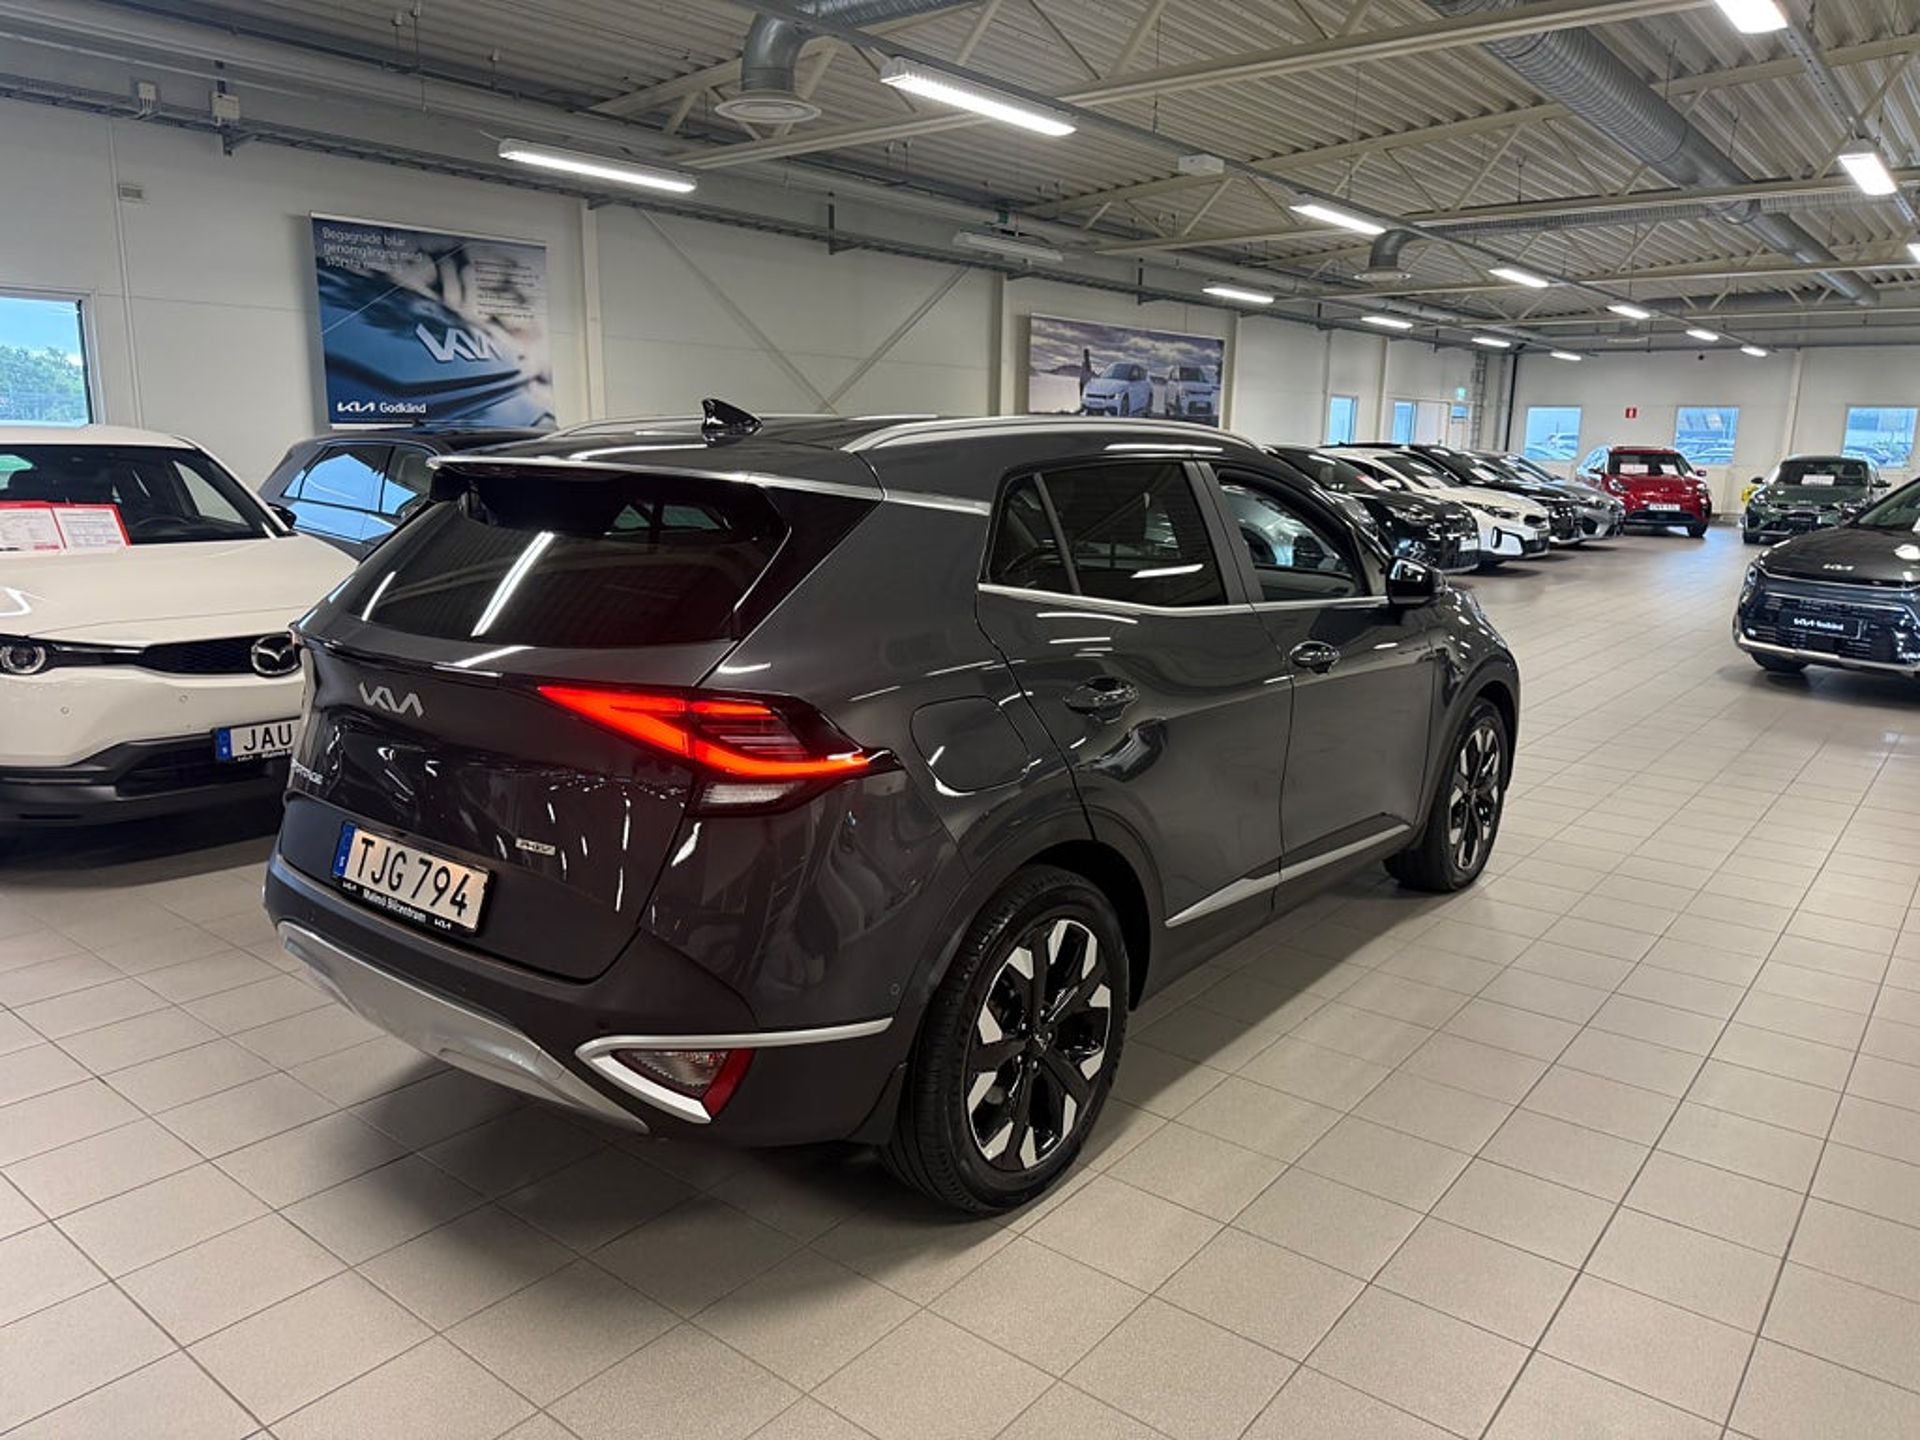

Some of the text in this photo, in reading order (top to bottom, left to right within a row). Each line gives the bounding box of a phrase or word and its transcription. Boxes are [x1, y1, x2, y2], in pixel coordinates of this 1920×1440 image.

[322, 226, 382, 245] Begagnade
[337, 401, 427, 414] KIA Godkänd
[359, 681, 424, 718] KIA
[243, 723, 293, 751] JAU
[357, 837, 471, 918] TJG 794
